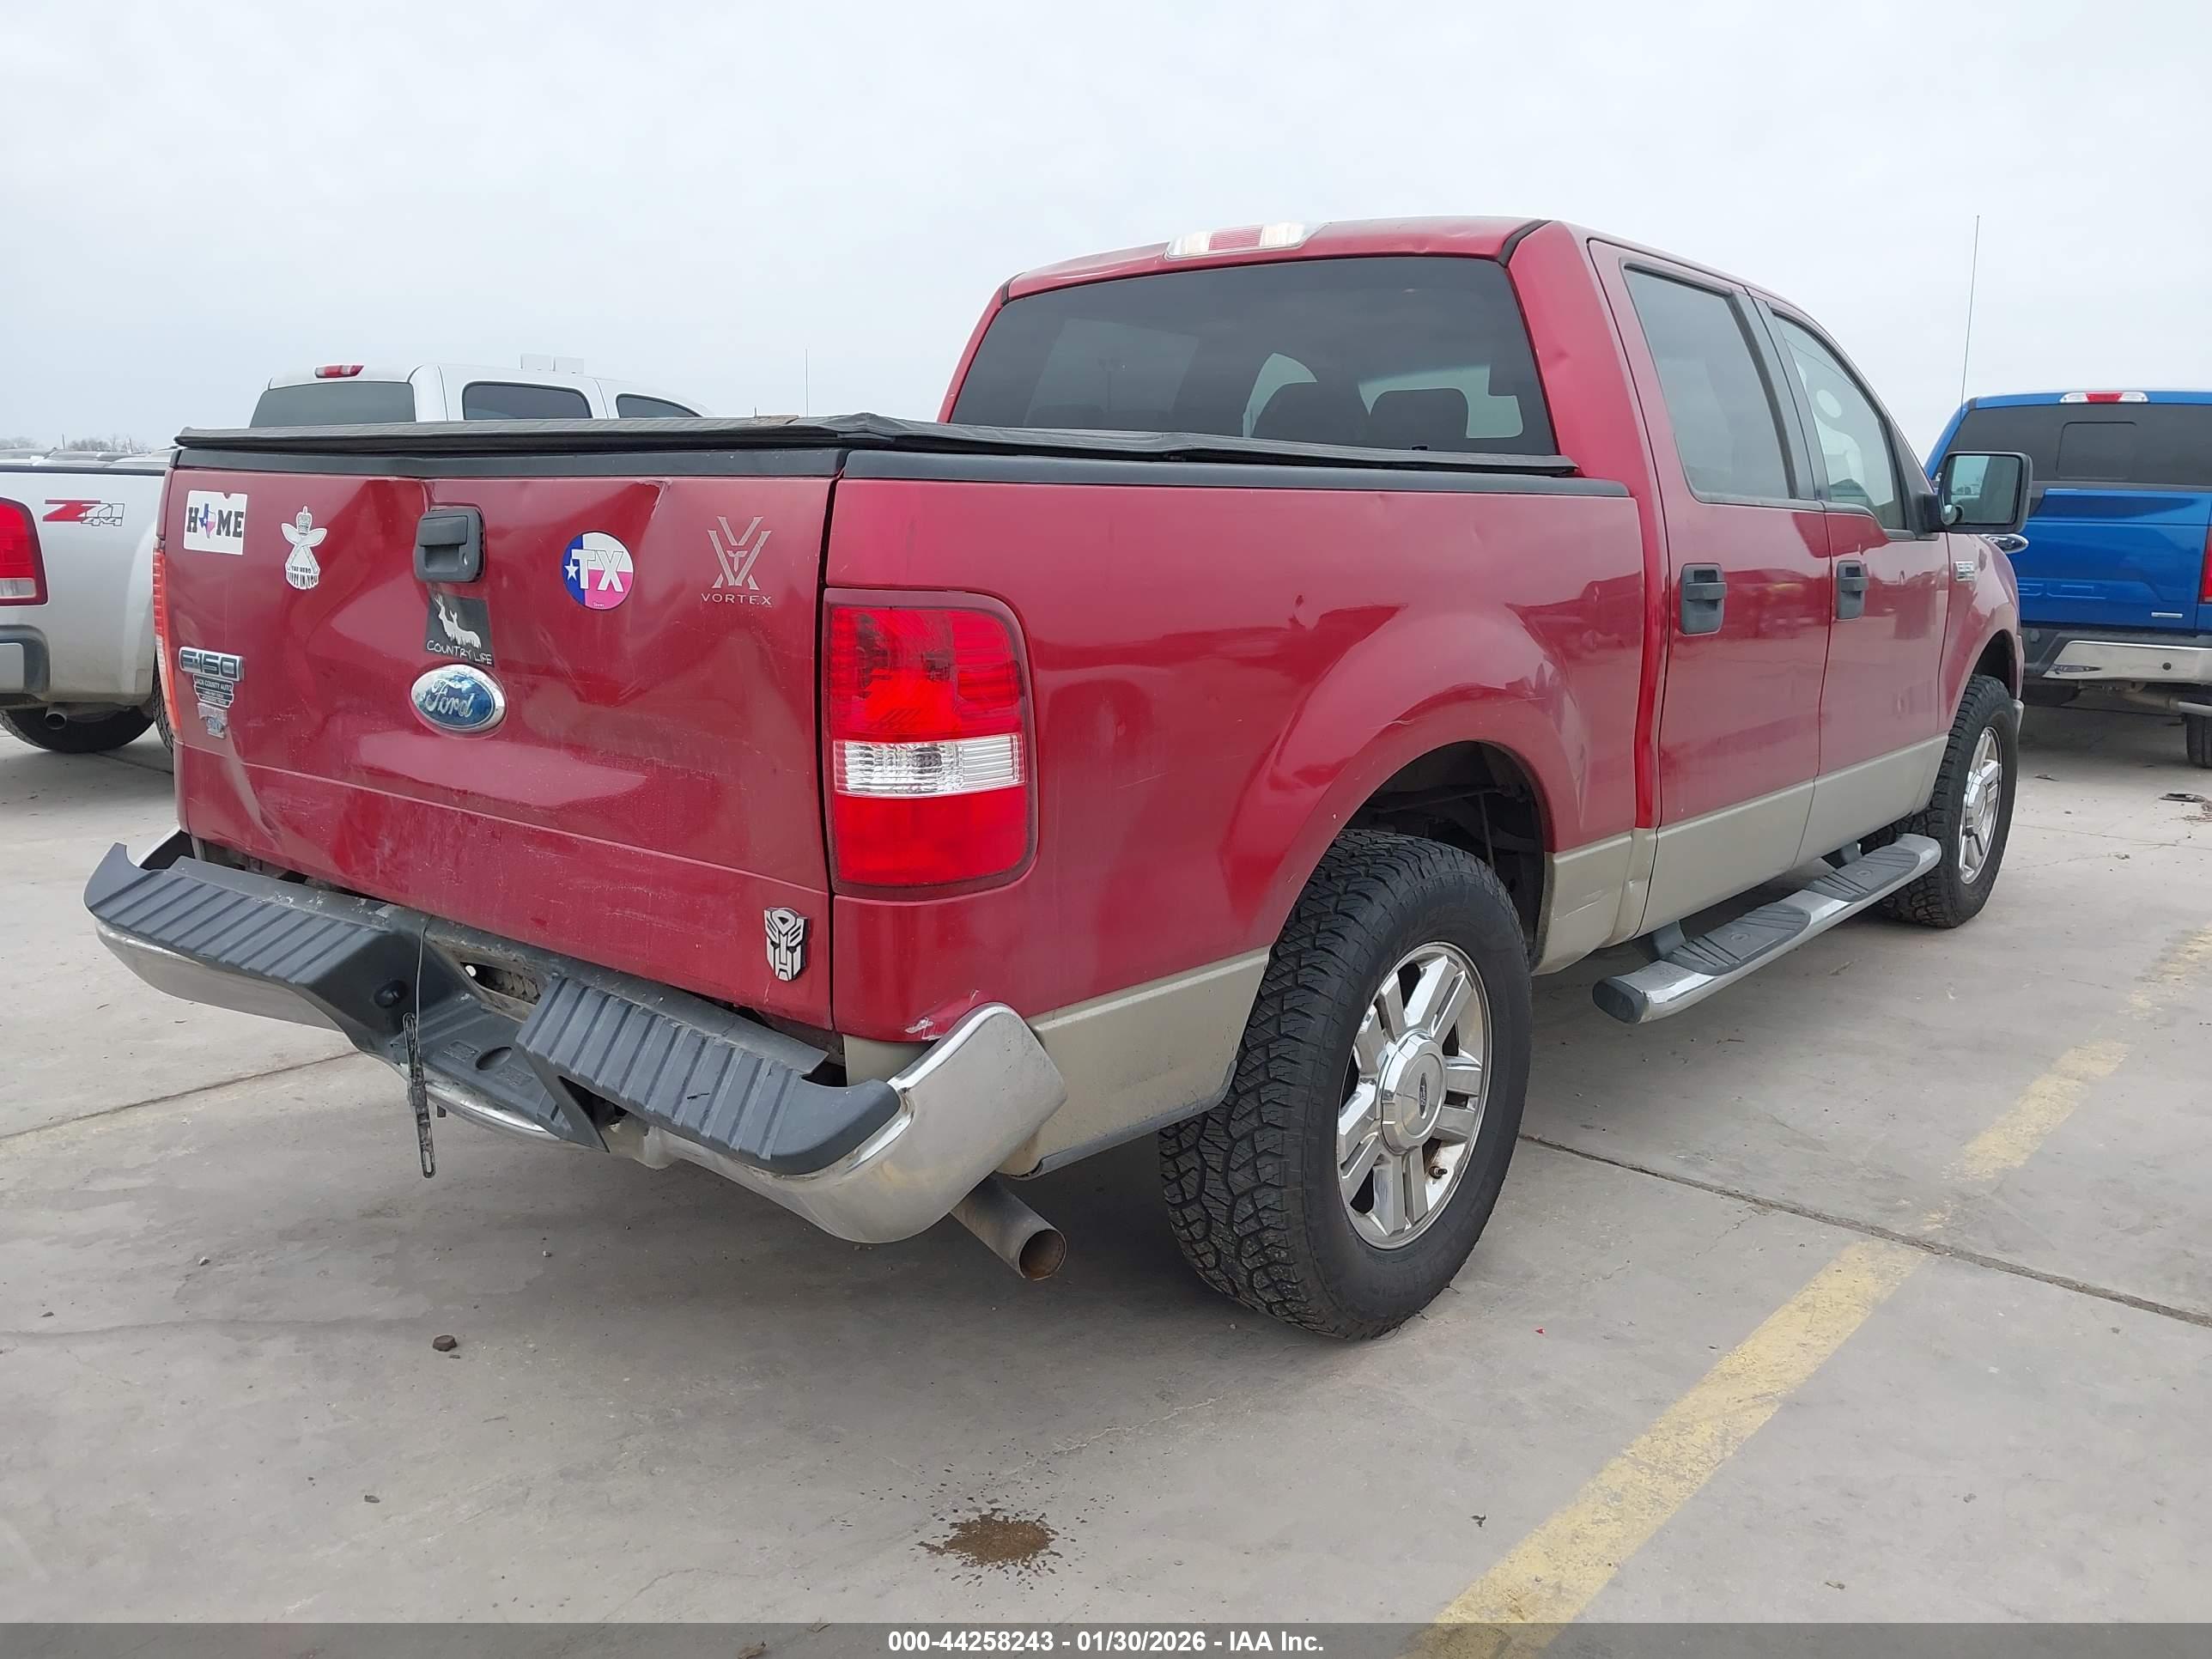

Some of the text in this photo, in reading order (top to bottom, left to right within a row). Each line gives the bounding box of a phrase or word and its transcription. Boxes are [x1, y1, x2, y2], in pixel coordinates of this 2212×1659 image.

[42, 500, 125, 521] Z71
[186, 507, 244, 538] HME
[571, 549, 624, 592] TX
[701, 592, 772, 605] VORTEX
[427, 640, 493, 665] COUNTRY LIFE
[424, 678, 474, 718] Ford
